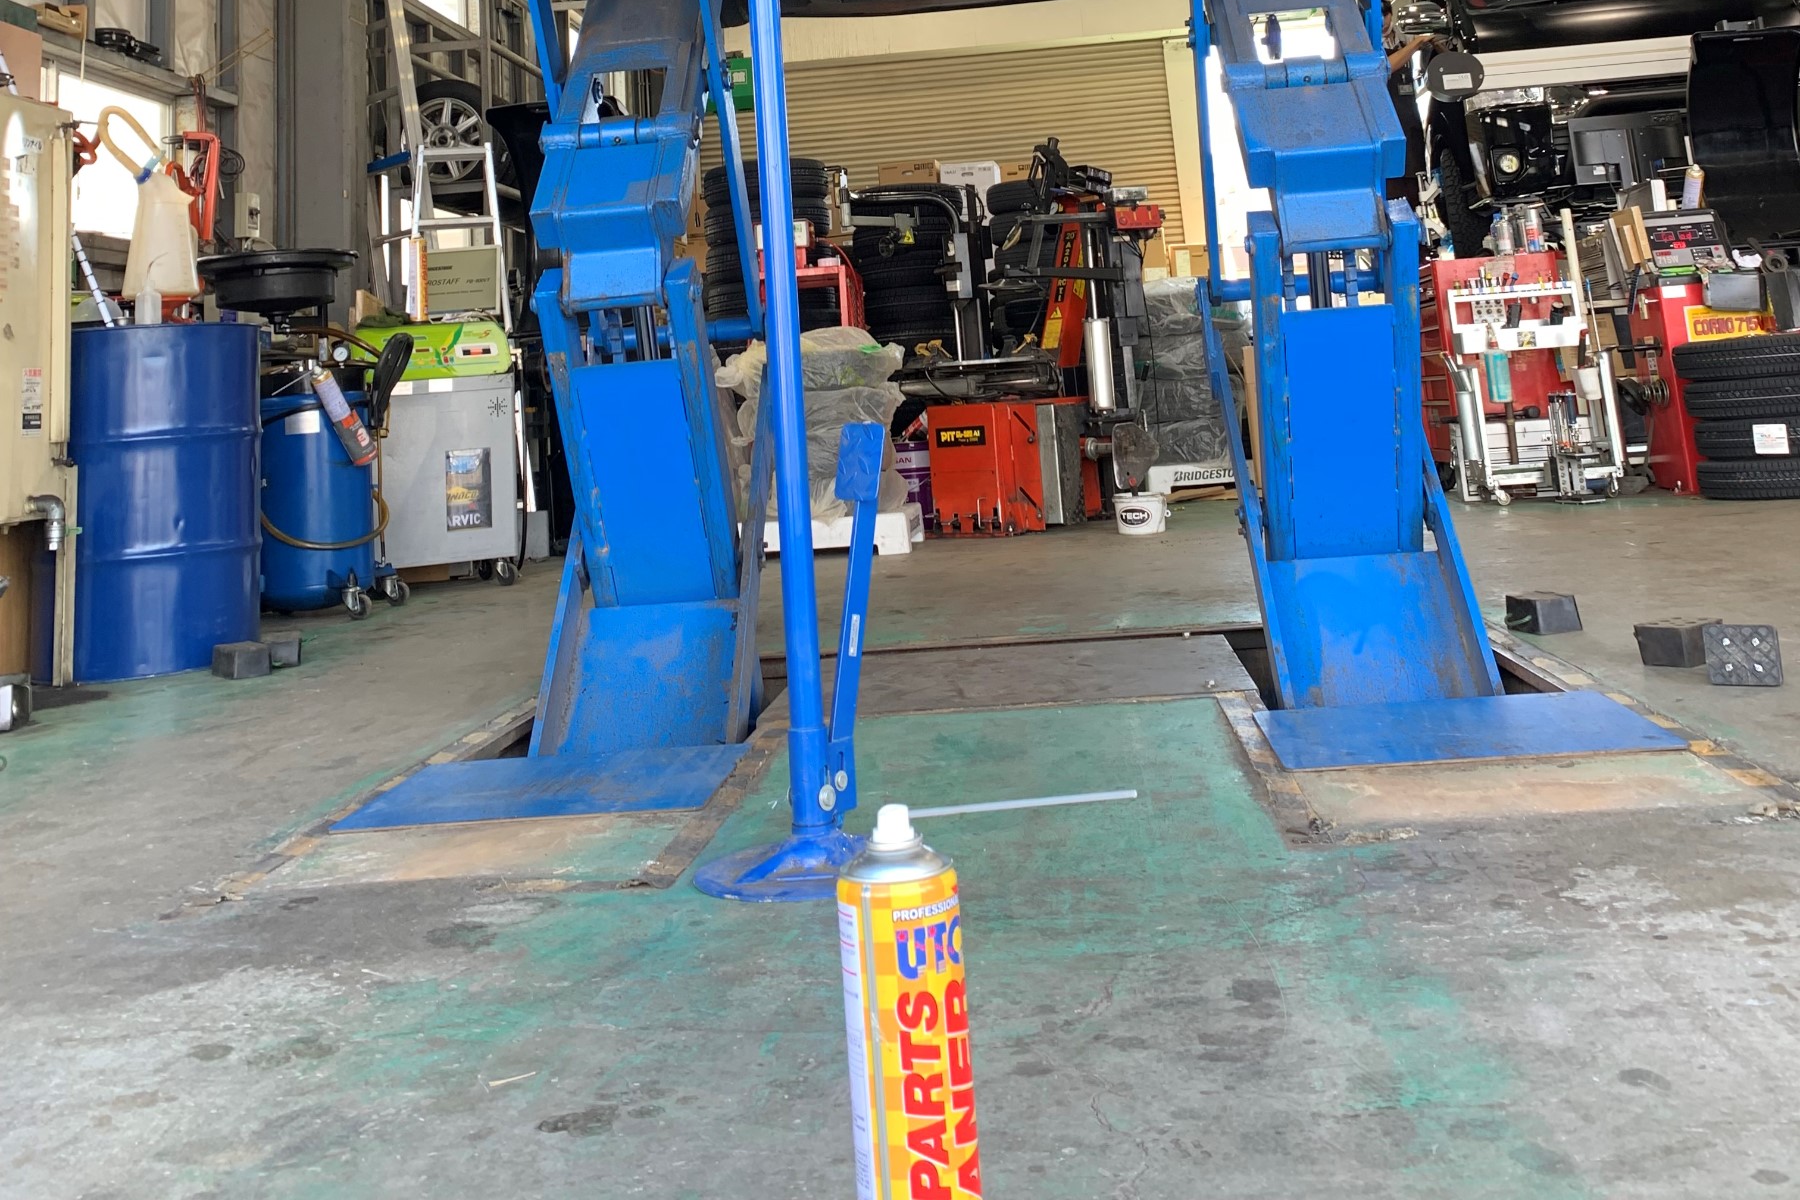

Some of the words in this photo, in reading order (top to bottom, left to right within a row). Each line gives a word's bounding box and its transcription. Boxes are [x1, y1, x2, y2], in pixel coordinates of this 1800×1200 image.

[1693, 317, 1735, 336] CORNO
[940, 431, 956, 443] PIT
[1121, 511, 1148, 520] TECH
[896, 990, 951, 1200] PARTS
